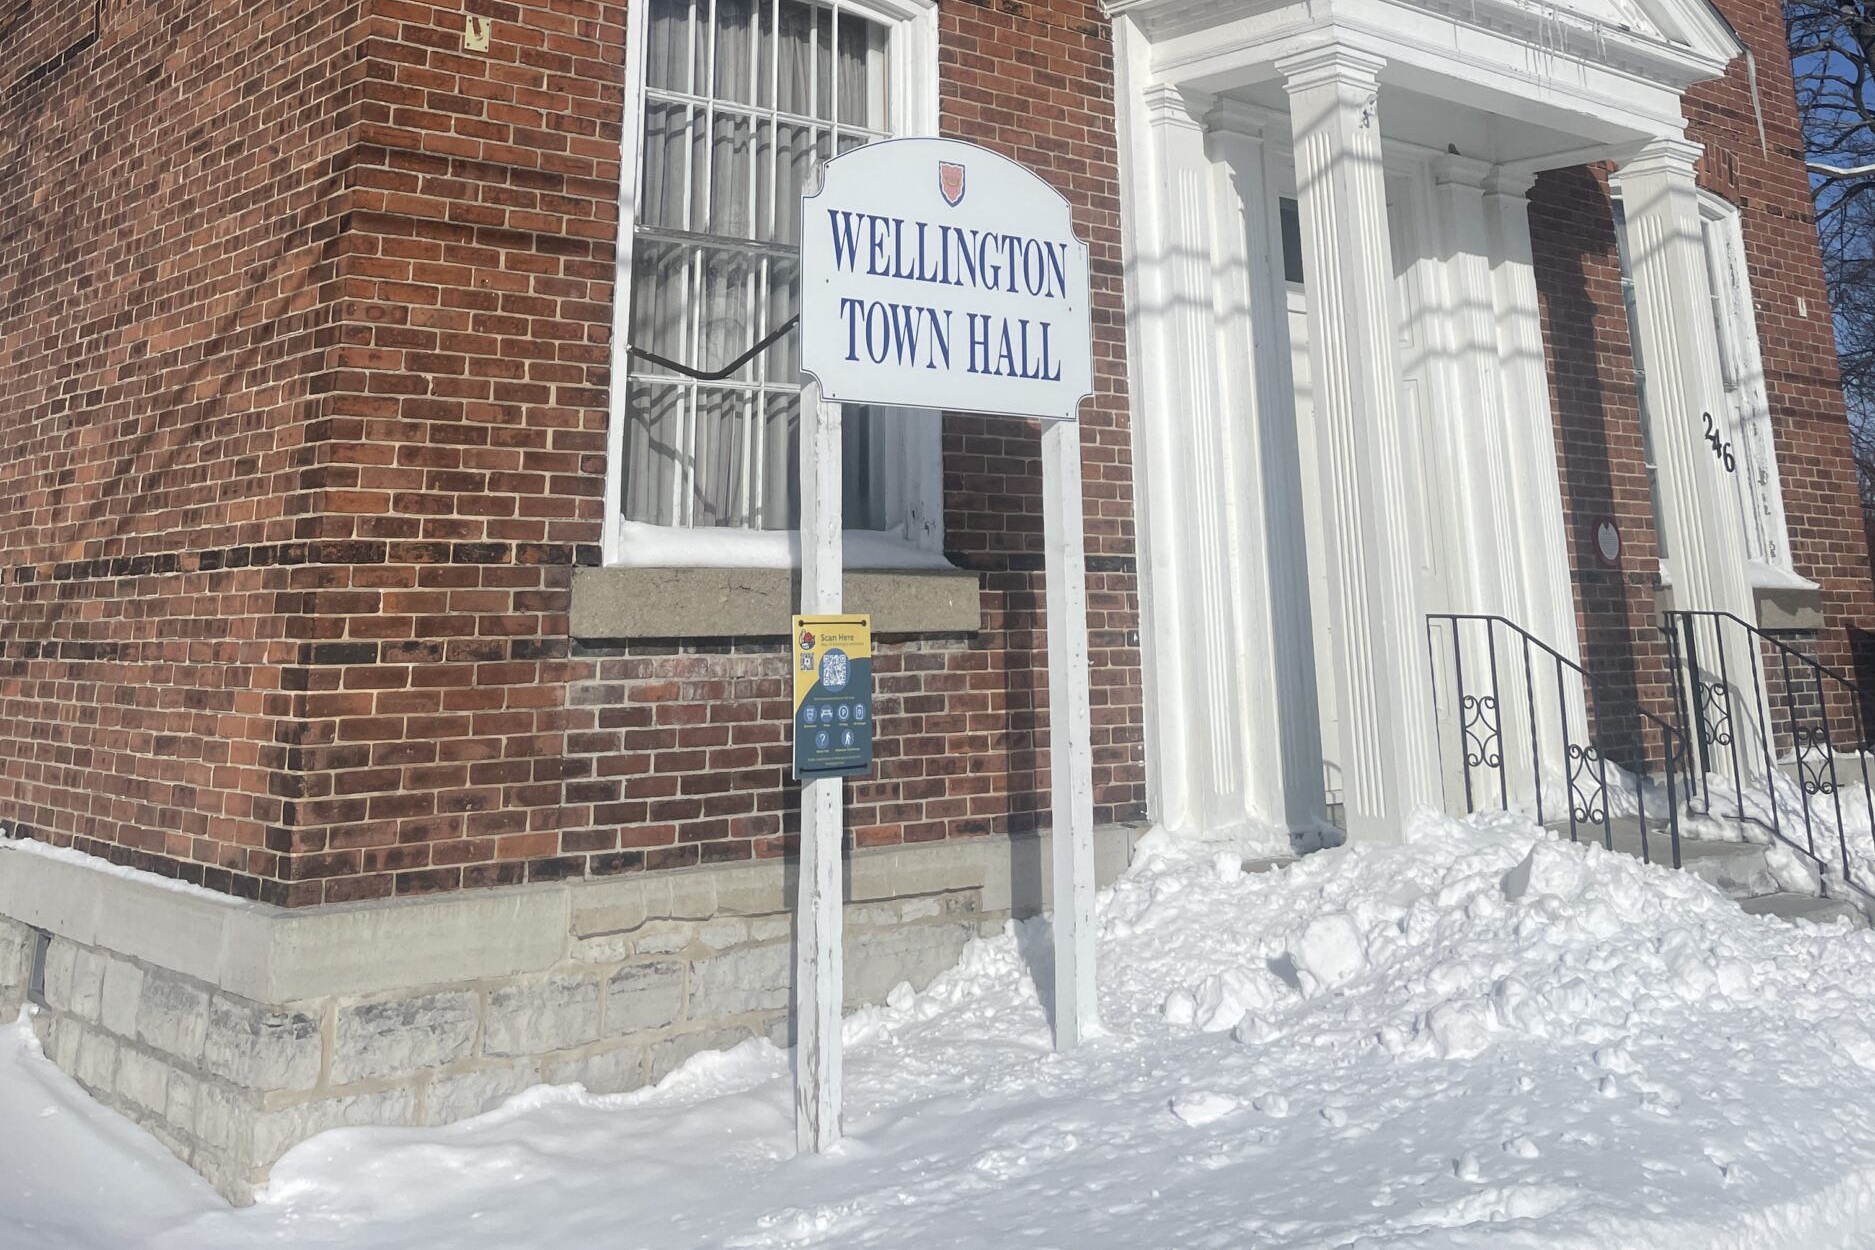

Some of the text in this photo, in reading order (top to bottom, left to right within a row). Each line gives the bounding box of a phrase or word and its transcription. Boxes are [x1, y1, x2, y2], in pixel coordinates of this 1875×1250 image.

[827, 209, 1067, 299] WELLINGTON
[840, 297, 1061, 382] TOWN HALL
[1702, 411, 1736, 473] 246
[820, 633, 854, 642] Scan Here
